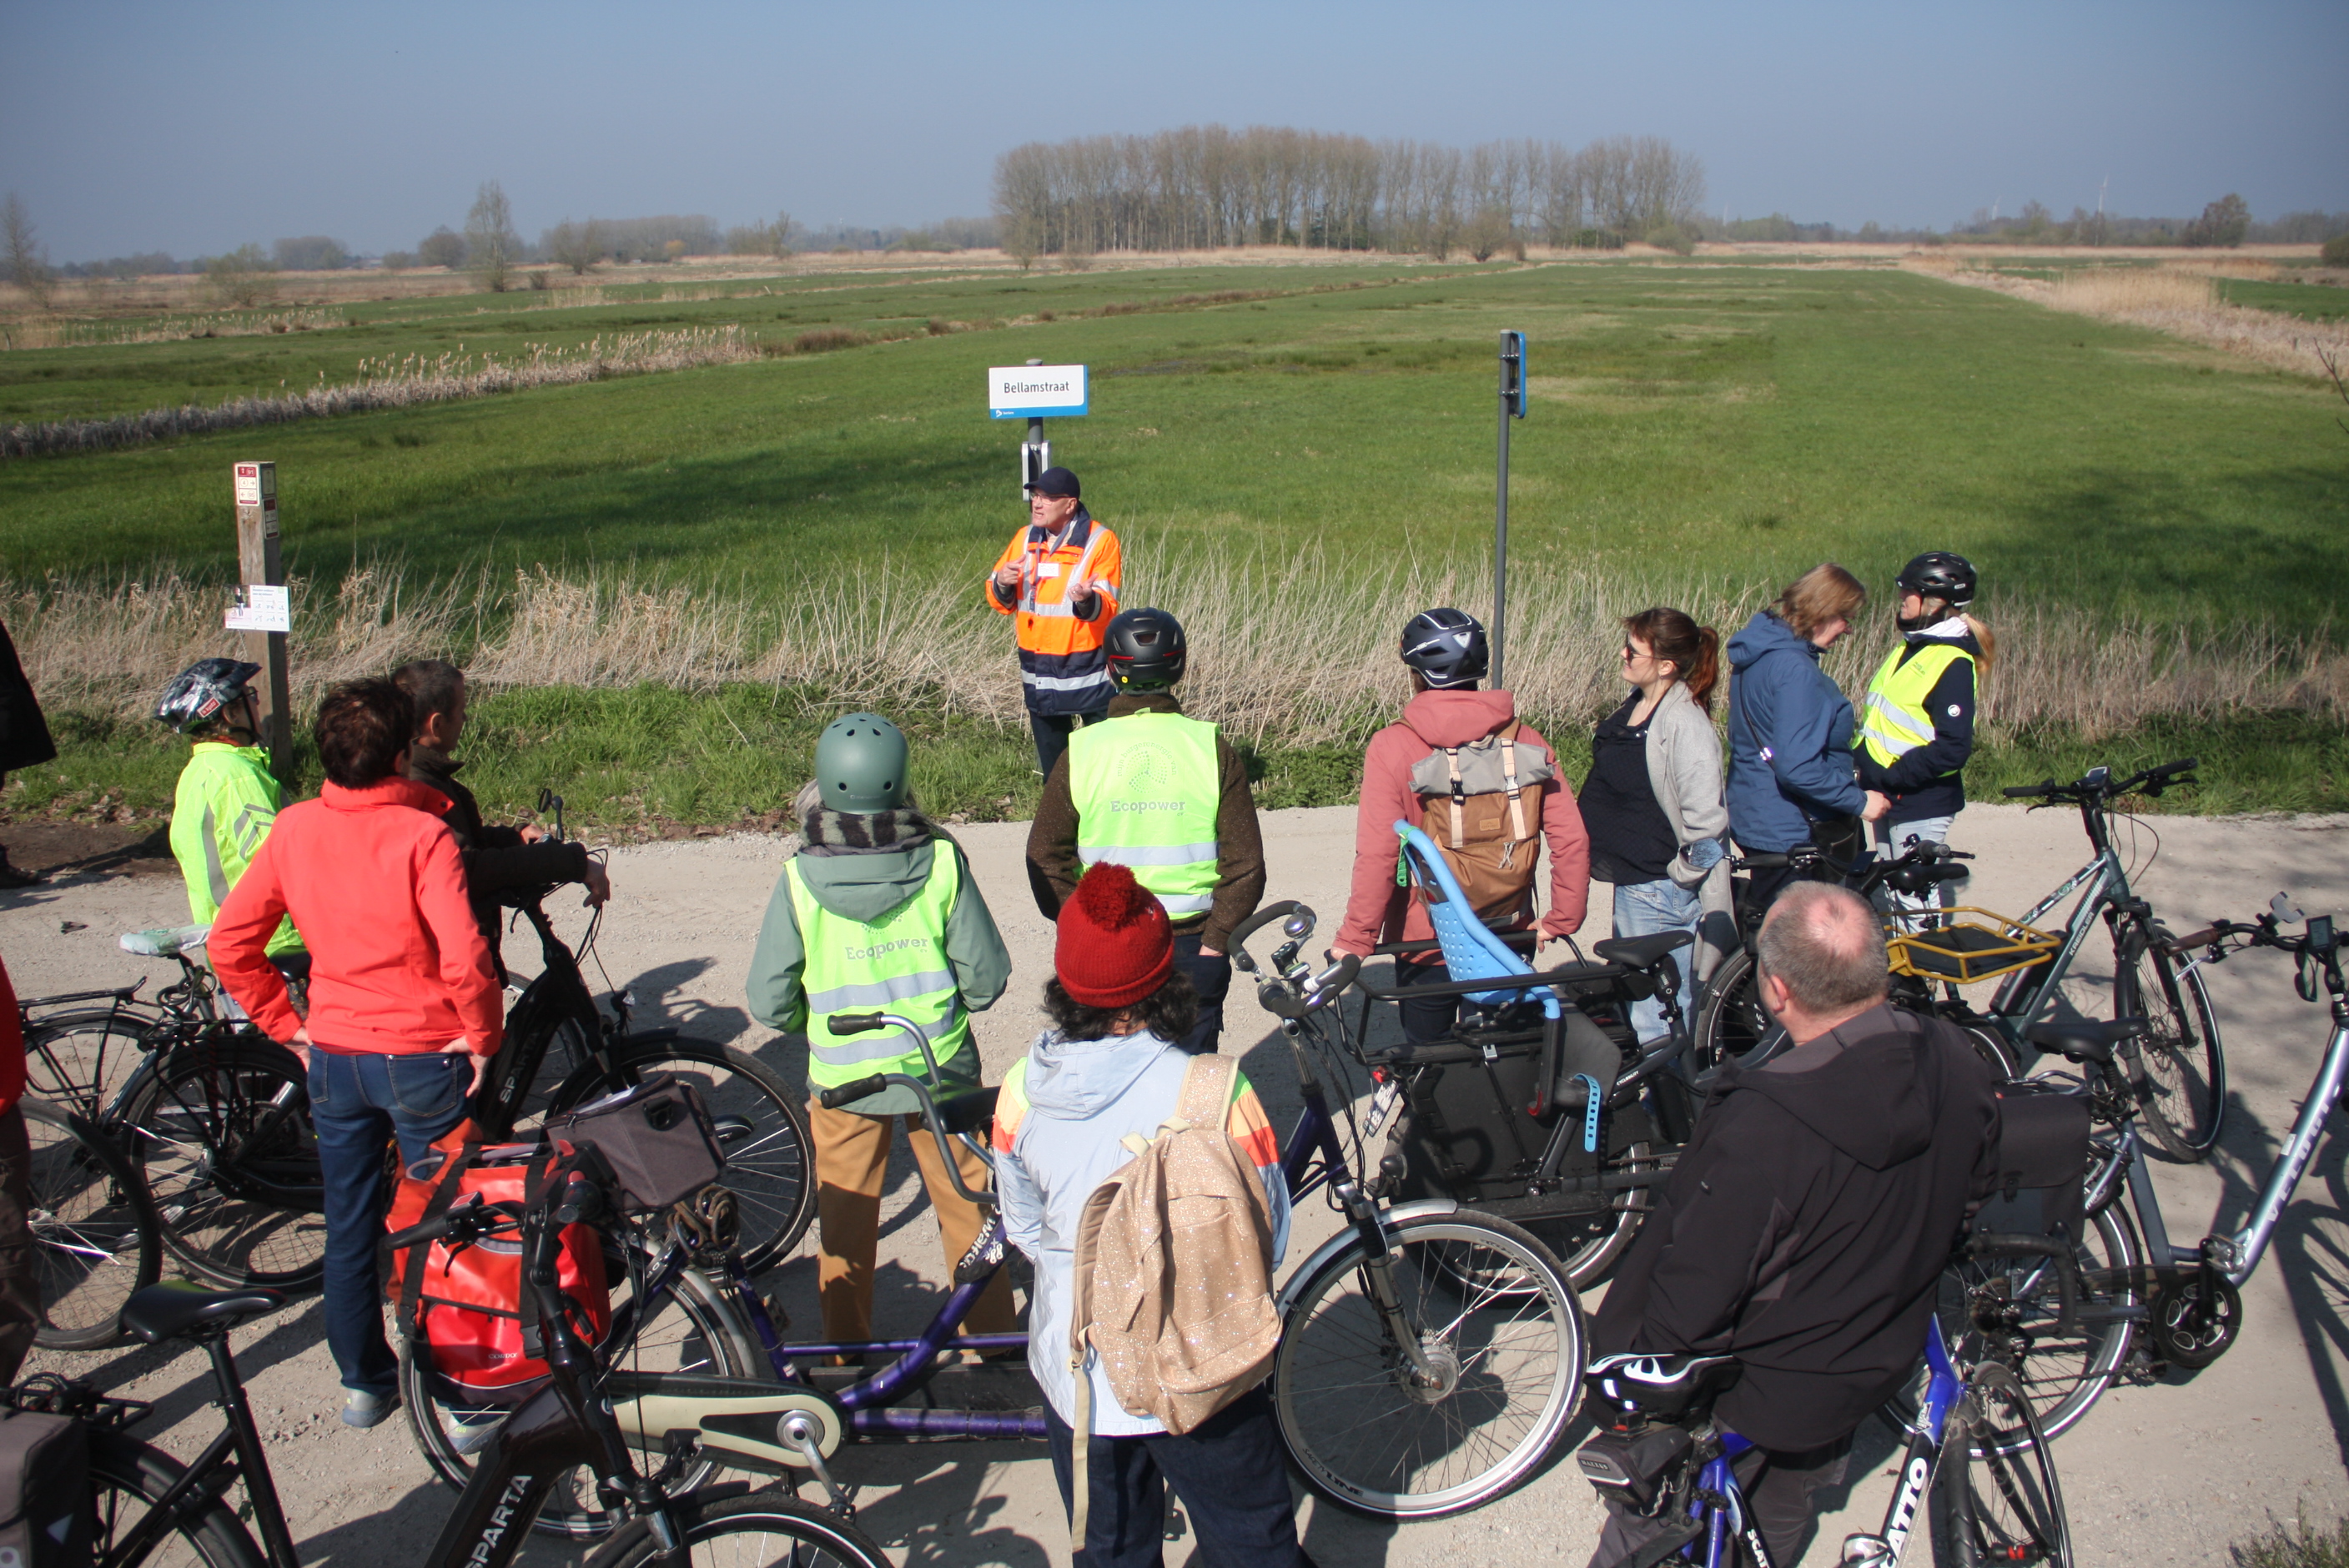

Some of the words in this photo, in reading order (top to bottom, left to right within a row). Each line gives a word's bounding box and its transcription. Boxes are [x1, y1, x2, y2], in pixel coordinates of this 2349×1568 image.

[1003, 381, 1069, 394] Bellamstraat
[1110, 801, 1186, 815] Ecopower
[2069, 911, 2095, 957] KREIDLER
[844, 938, 928, 960] Ecopower
[500, 1032, 541, 1103] SPARTA
